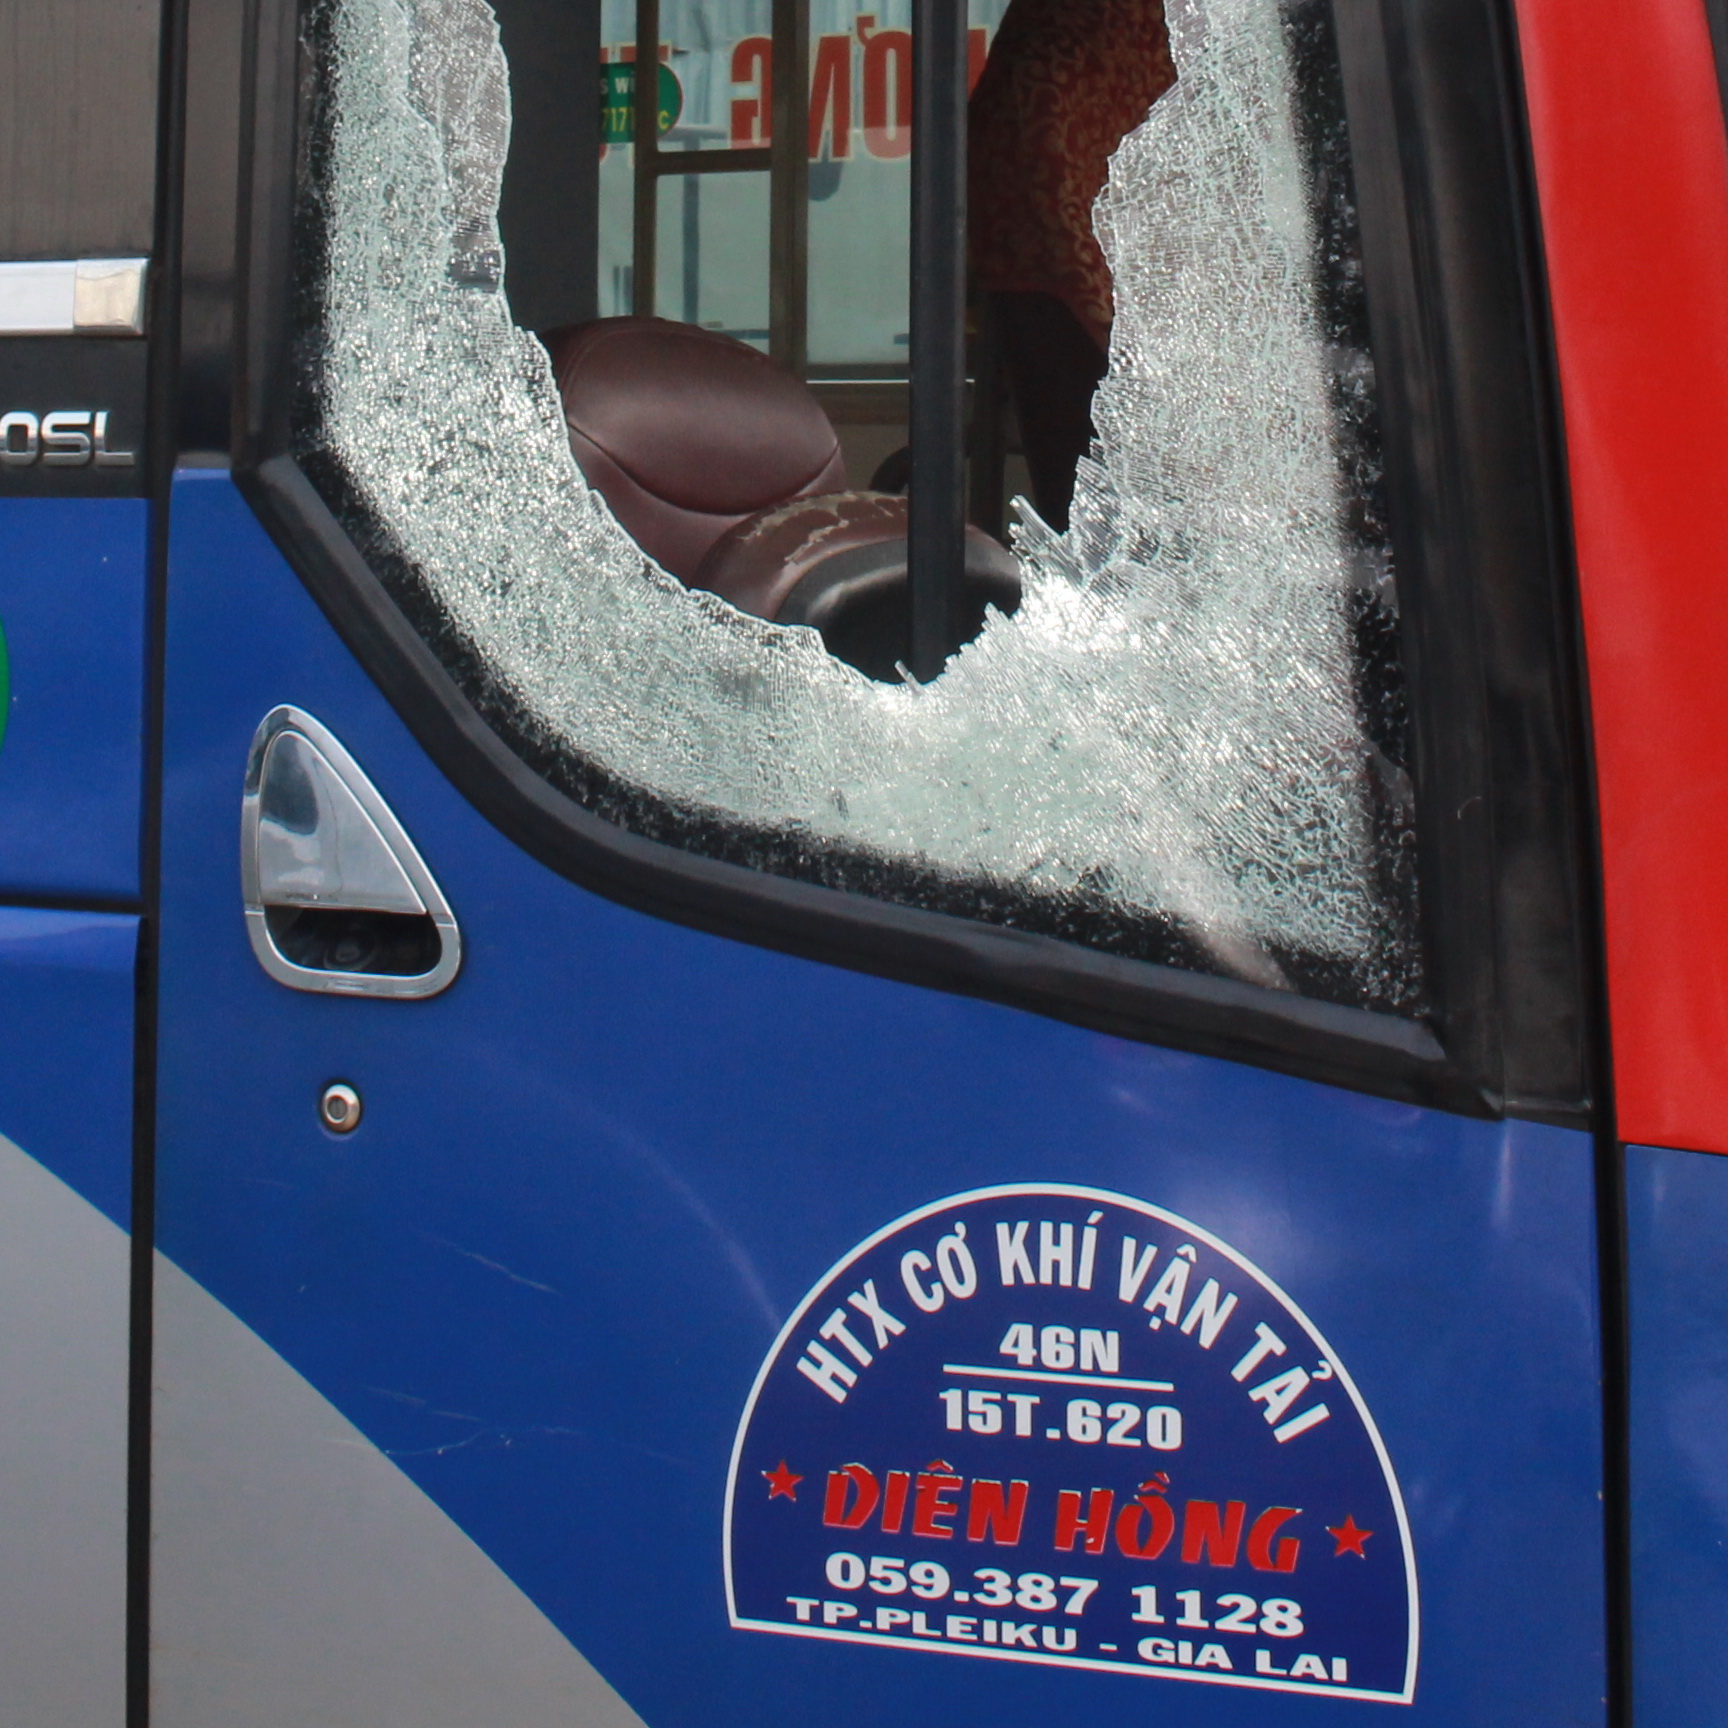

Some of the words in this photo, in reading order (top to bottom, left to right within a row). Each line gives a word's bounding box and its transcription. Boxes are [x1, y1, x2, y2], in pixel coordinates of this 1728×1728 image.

[796, 1279, 907, 1404] HTX
[899, 1221, 978, 1314] CƠ
[995, 1211, 1105, 1290] KHÍ
[1120, 1236, 1239, 1350] VẬN
[1230, 1321, 1334, 1444] TẢI
[999, 1322, 1120, 1373] 46N
[938, 1388, 1183, 1451] 15T.620
[1054, 1472, 1302, 1574] HỒNG
[825, 1552, 1099, 1616] 059.387
[1131, 1585, 1305, 1639] 1128
[786, 1596, 1078, 1653] TP.PLEIKU
[1137, 1637, 1234, 1671] GIA
[1255, 1649, 1349, 1683] LAI
